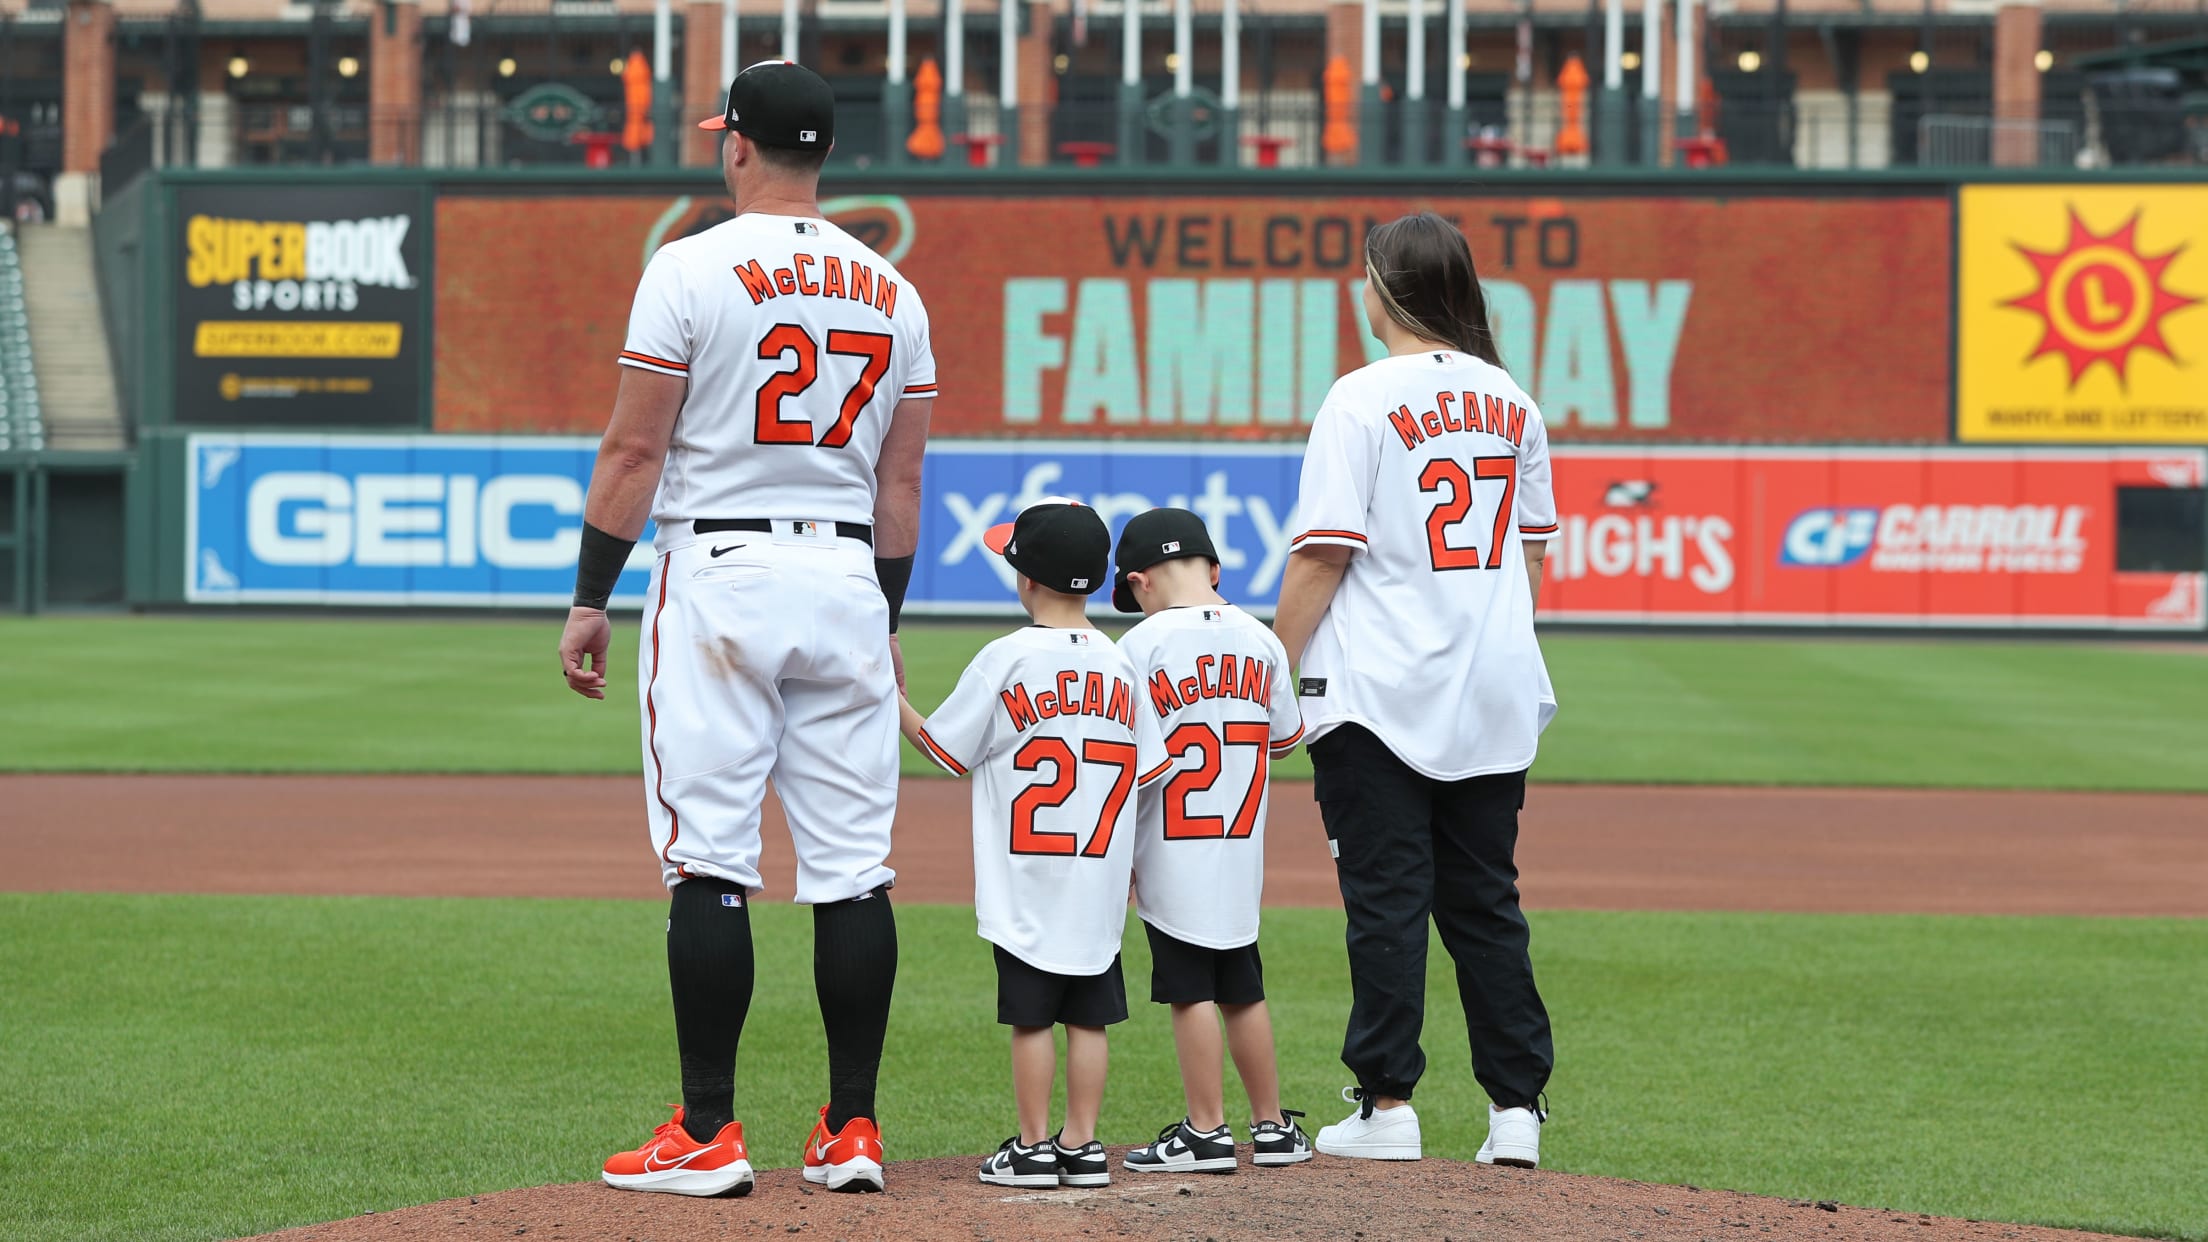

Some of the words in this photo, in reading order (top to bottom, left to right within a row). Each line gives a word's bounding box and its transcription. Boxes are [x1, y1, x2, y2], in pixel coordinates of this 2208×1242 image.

[187, 214, 411, 289] SUPERBOOK
[1105, 215, 1462, 269] WELCO
[1490, 216, 1580, 269] TO
[233, 279, 359, 311] SPORTS
[733, 253, 898, 319] McCANN
[754, 323, 893, 448] 27
[1388, 391, 1526, 451] McCANN
[247, 471, 654, 570] GEIC
[1418, 456, 1516, 572] 27
[1001, 670, 1135, 733] McCAN
[1010, 736, 1137, 858] 27
[1163, 721, 1270, 840] 27
